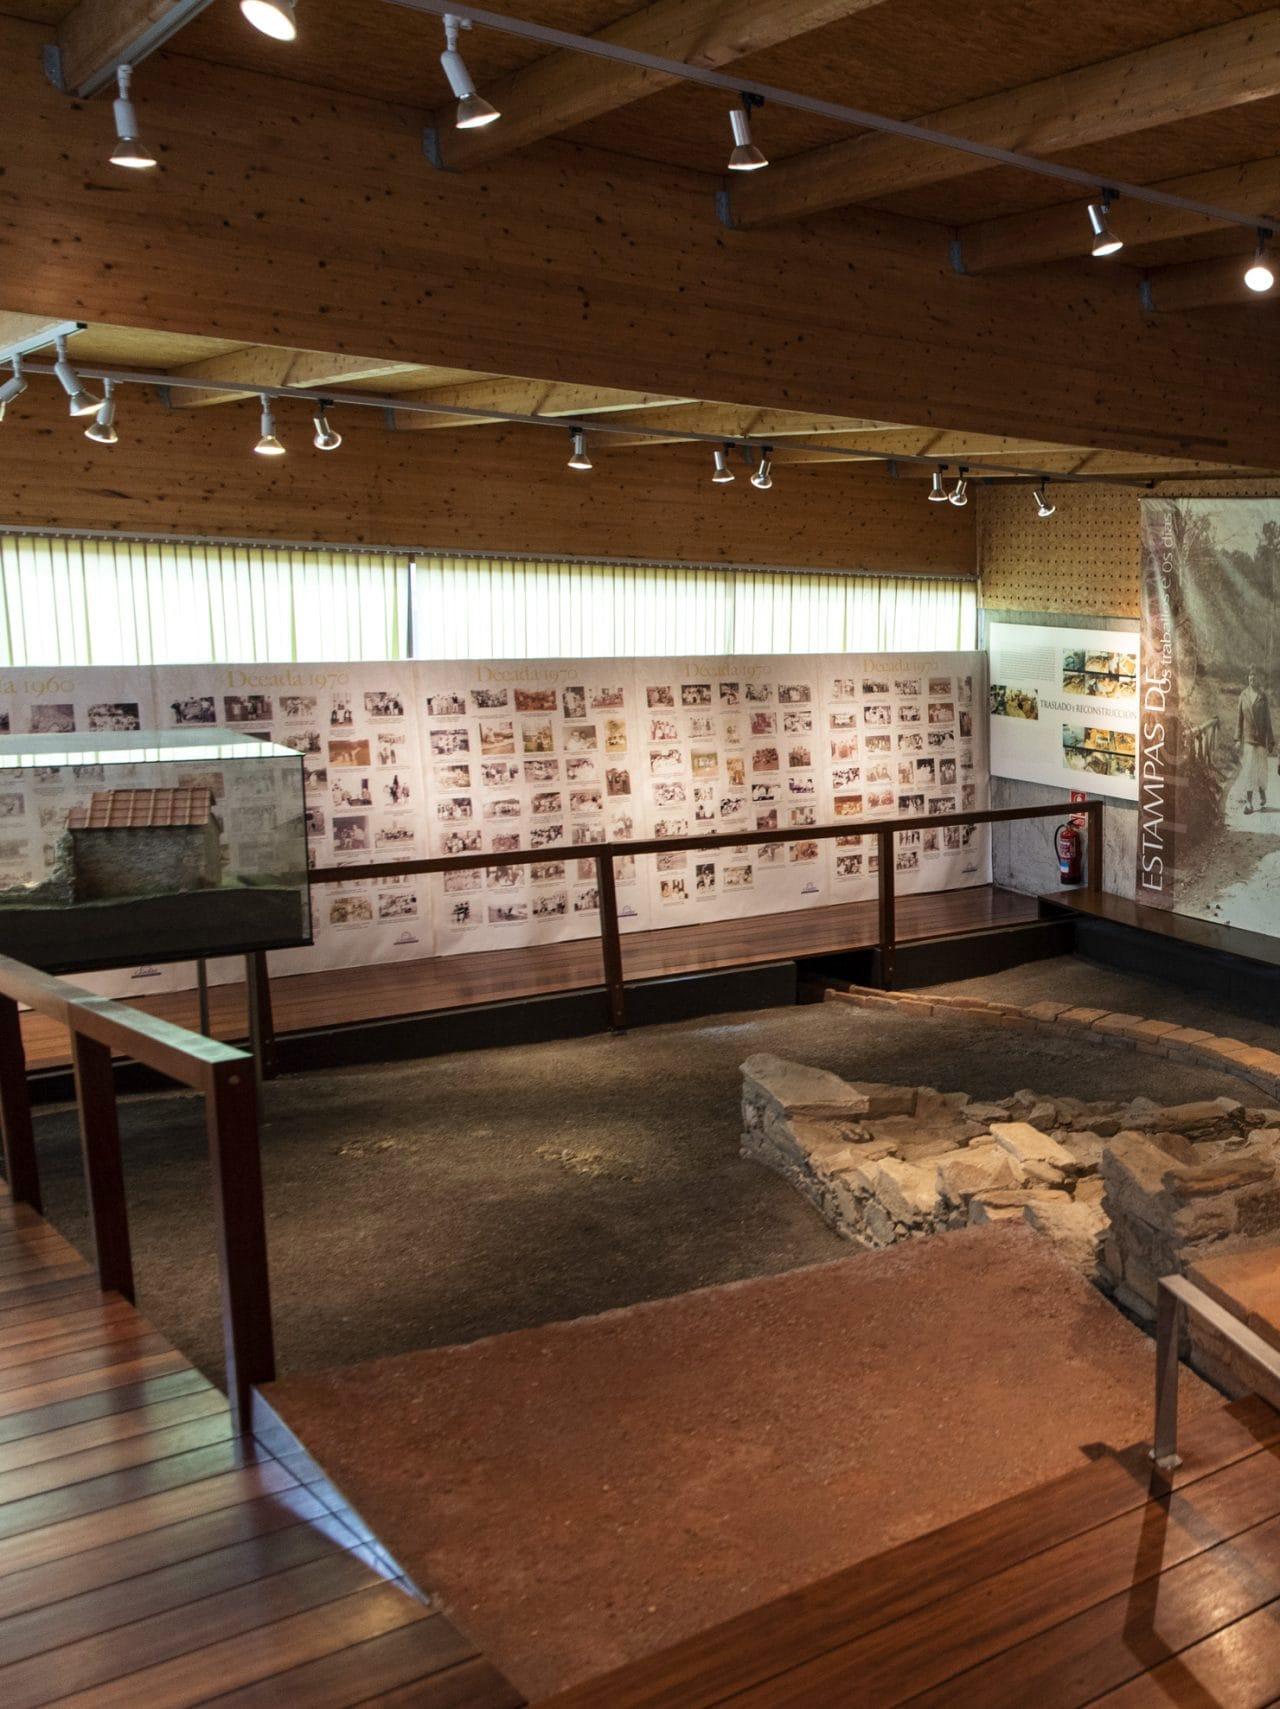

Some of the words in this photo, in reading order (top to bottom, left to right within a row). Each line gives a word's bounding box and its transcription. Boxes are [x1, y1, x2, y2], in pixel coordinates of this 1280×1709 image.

[1161, 552, 1173, 573] os
[1161, 578, 1171, 589] e
[24, 675, 75, 697] 1960
[1144, 666, 1166, 713] DE
[1040, 699, 1071, 711] TRASLADO
[1142, 722, 1165, 892] ESTAMPAS
